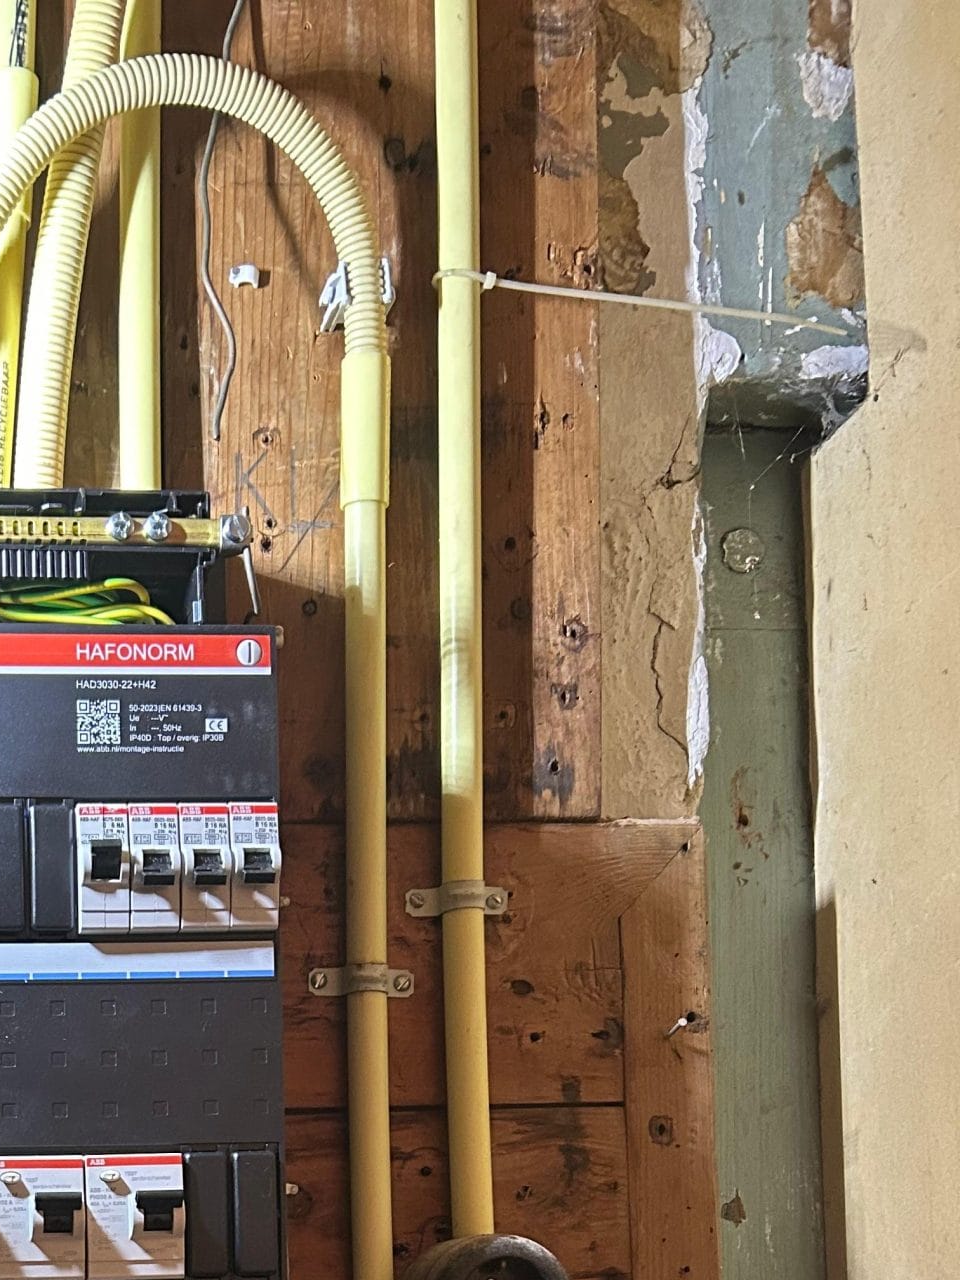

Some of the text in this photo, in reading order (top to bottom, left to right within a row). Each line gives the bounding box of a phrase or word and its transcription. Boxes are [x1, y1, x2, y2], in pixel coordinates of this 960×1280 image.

[76, 643, 195, 661] HAFONORM
[76, 680, 157, 690] HAD3030-22+H42
[173, 704, 203, 712] 61439-3
[163, 724, 182, 732] 50Hz
[129, 734, 152, 742] IP40D
[157, 734, 172, 743] Top
[77, 745, 185, 754] www.abb.nl/montage-instructie
